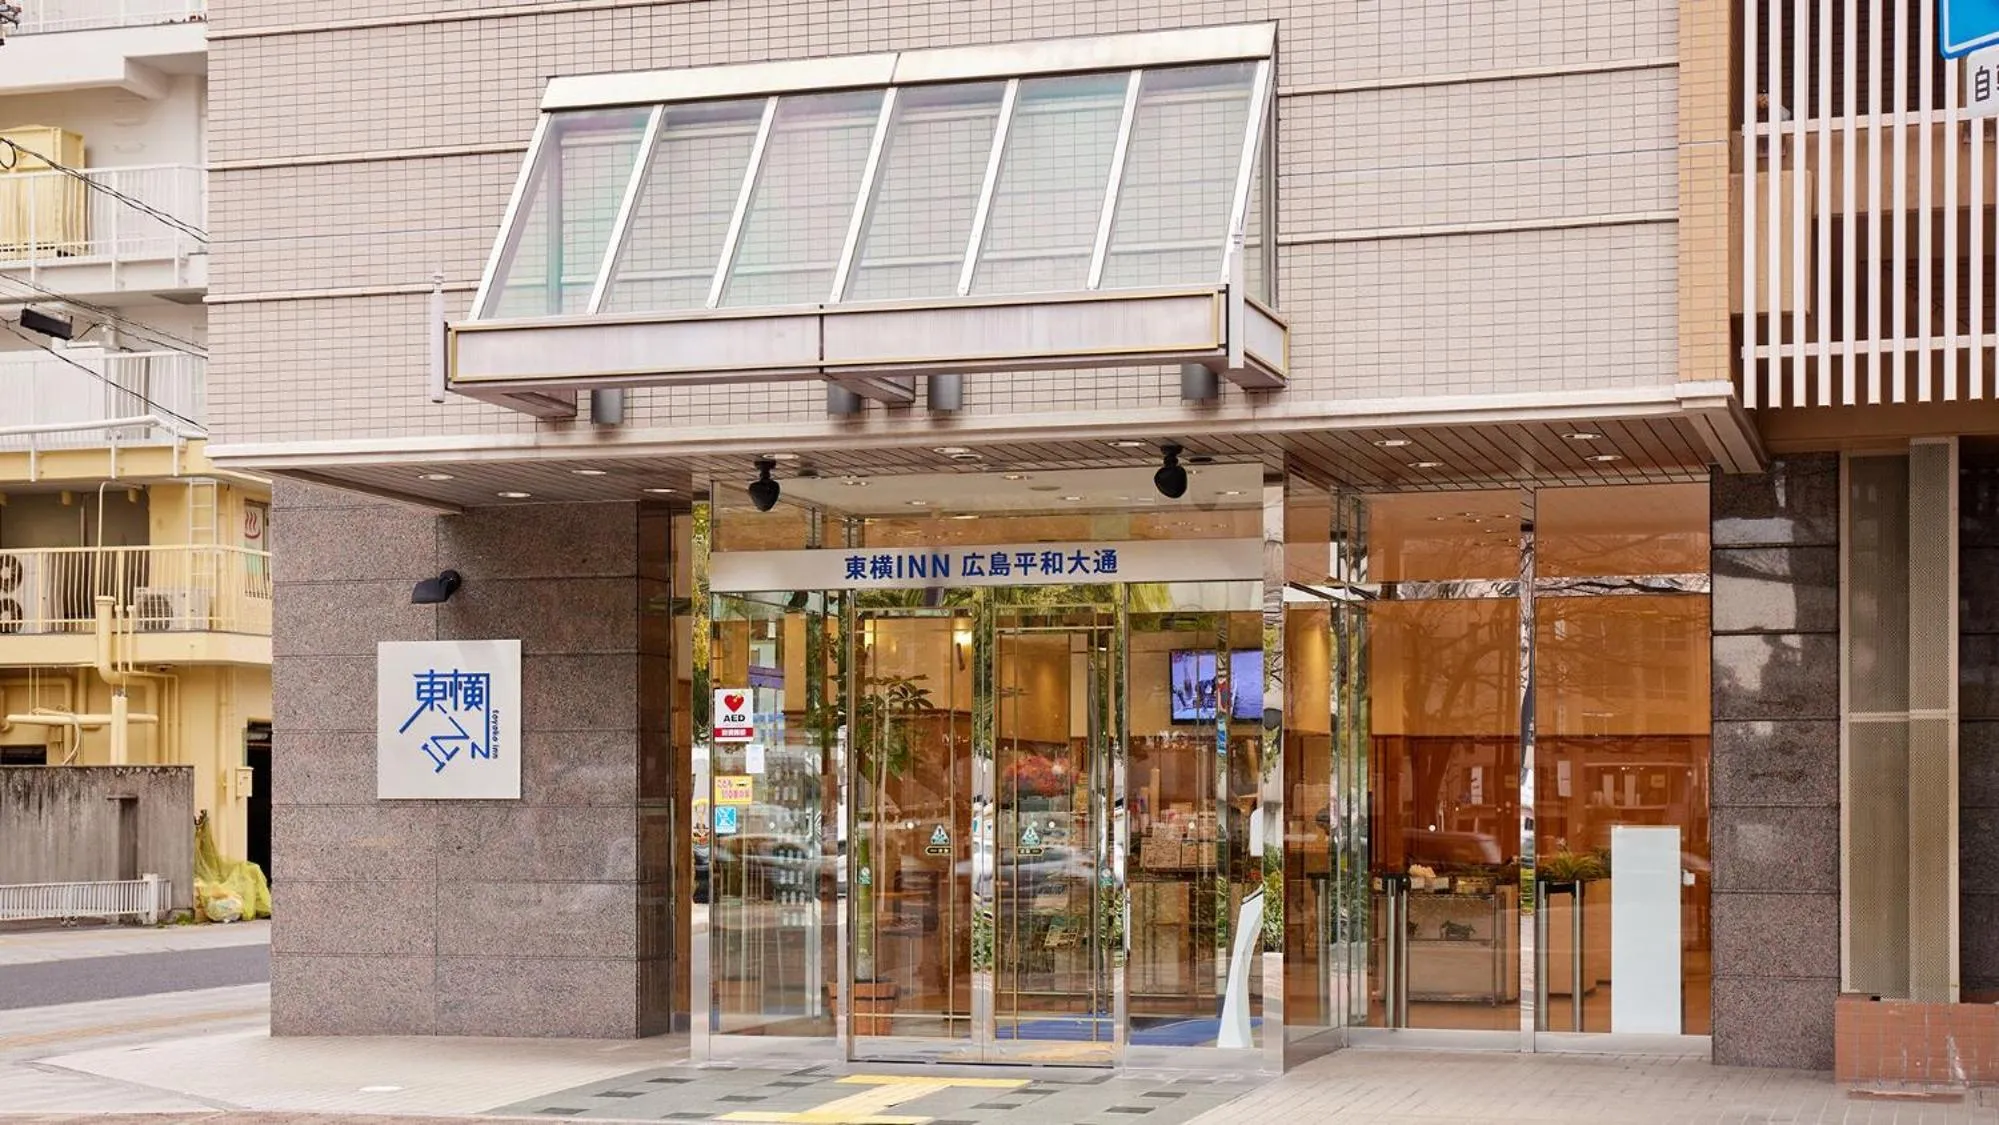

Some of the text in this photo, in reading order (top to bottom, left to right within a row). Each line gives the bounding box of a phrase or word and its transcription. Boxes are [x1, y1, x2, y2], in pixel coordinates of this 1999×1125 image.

[1974, 65, 1999, 102] 自
[844, 549, 1119, 580] 東横INN 広島平和大通
[491, 709, 500, 759] toyoko inn
[723, 714, 746, 723] AED
